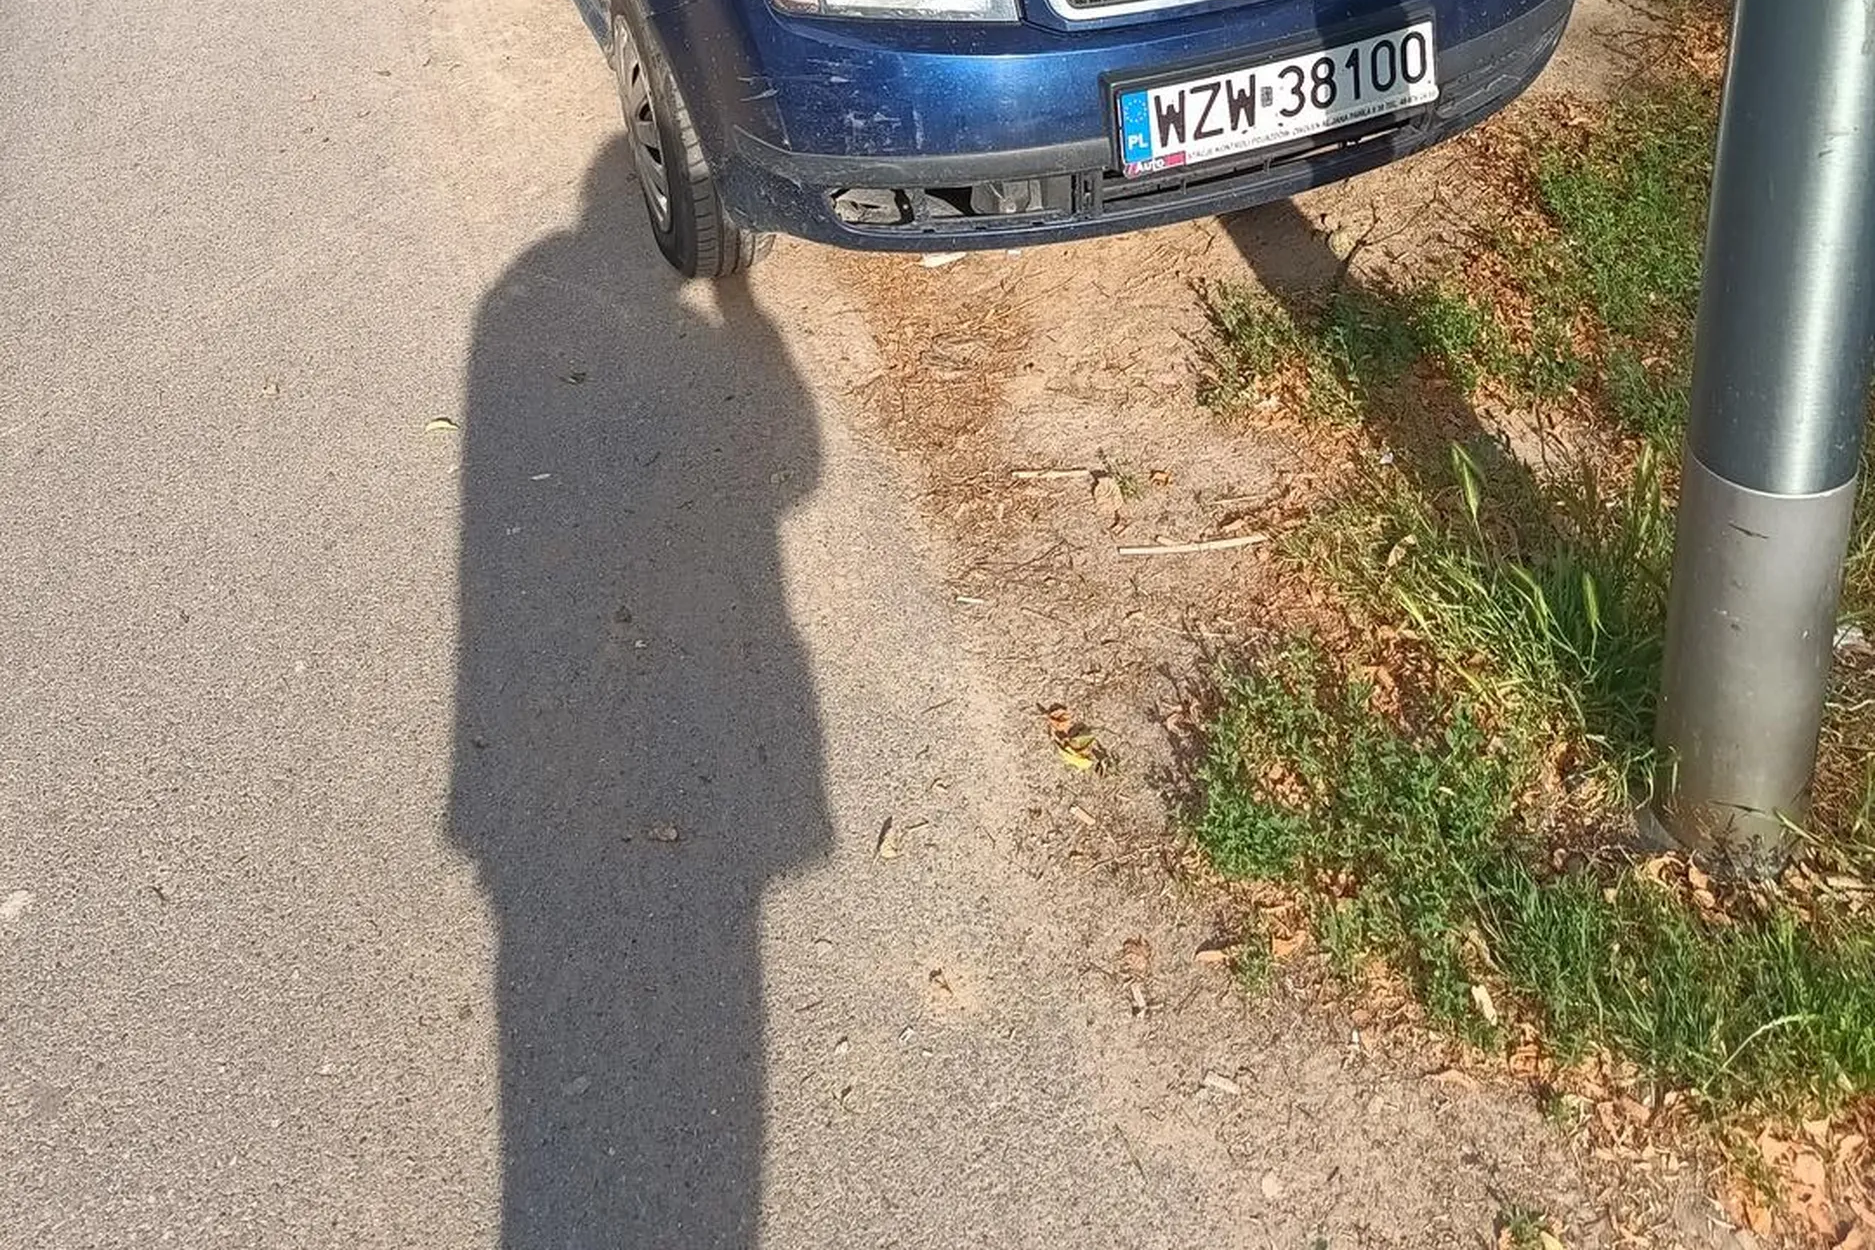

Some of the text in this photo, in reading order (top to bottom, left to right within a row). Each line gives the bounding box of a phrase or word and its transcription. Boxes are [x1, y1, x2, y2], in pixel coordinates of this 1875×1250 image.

[1154, 31, 1427, 148] WZW 38100
[1128, 134, 1148, 150] PL
